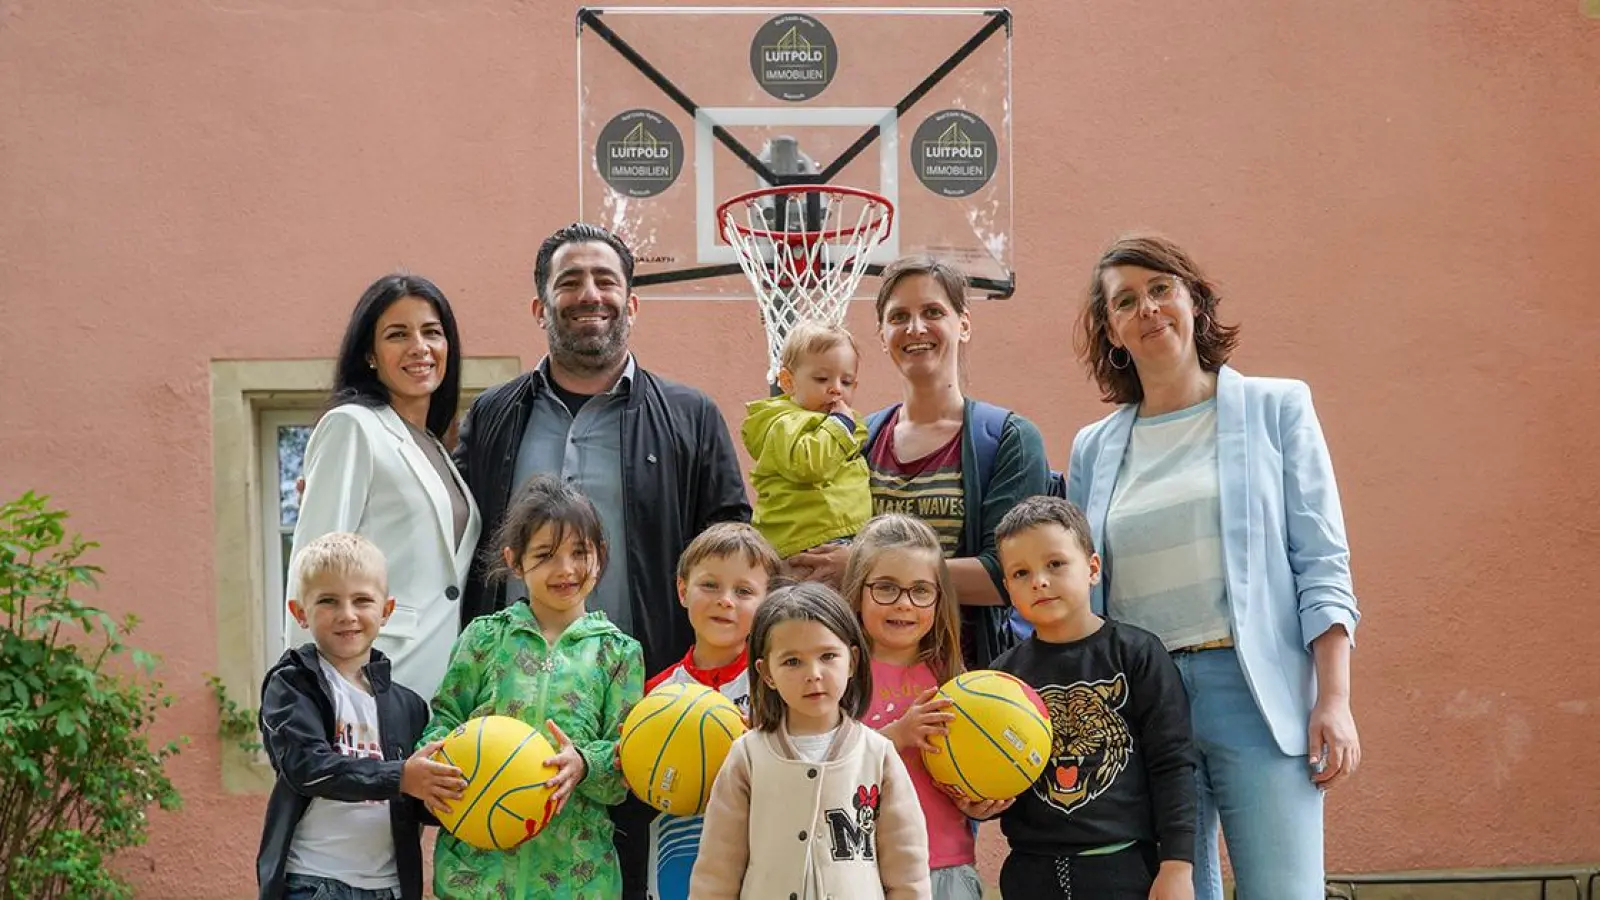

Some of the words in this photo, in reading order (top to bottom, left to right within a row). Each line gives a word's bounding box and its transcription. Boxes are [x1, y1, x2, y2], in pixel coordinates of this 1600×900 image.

[765, 50, 823, 62] LUITPOLD
[766, 69, 823, 80] IMMOBILIEN
[611, 147, 669, 158] LUITPOLD
[926, 147, 983, 158] LUITPOLD
[611, 166, 670, 177] IMMOBILIEN
[926, 165, 983, 176] IMMOBILIEN
[873, 498, 914, 516] MAKE
[917, 497, 965, 516] WAVES
[824, 807, 875, 862] M
